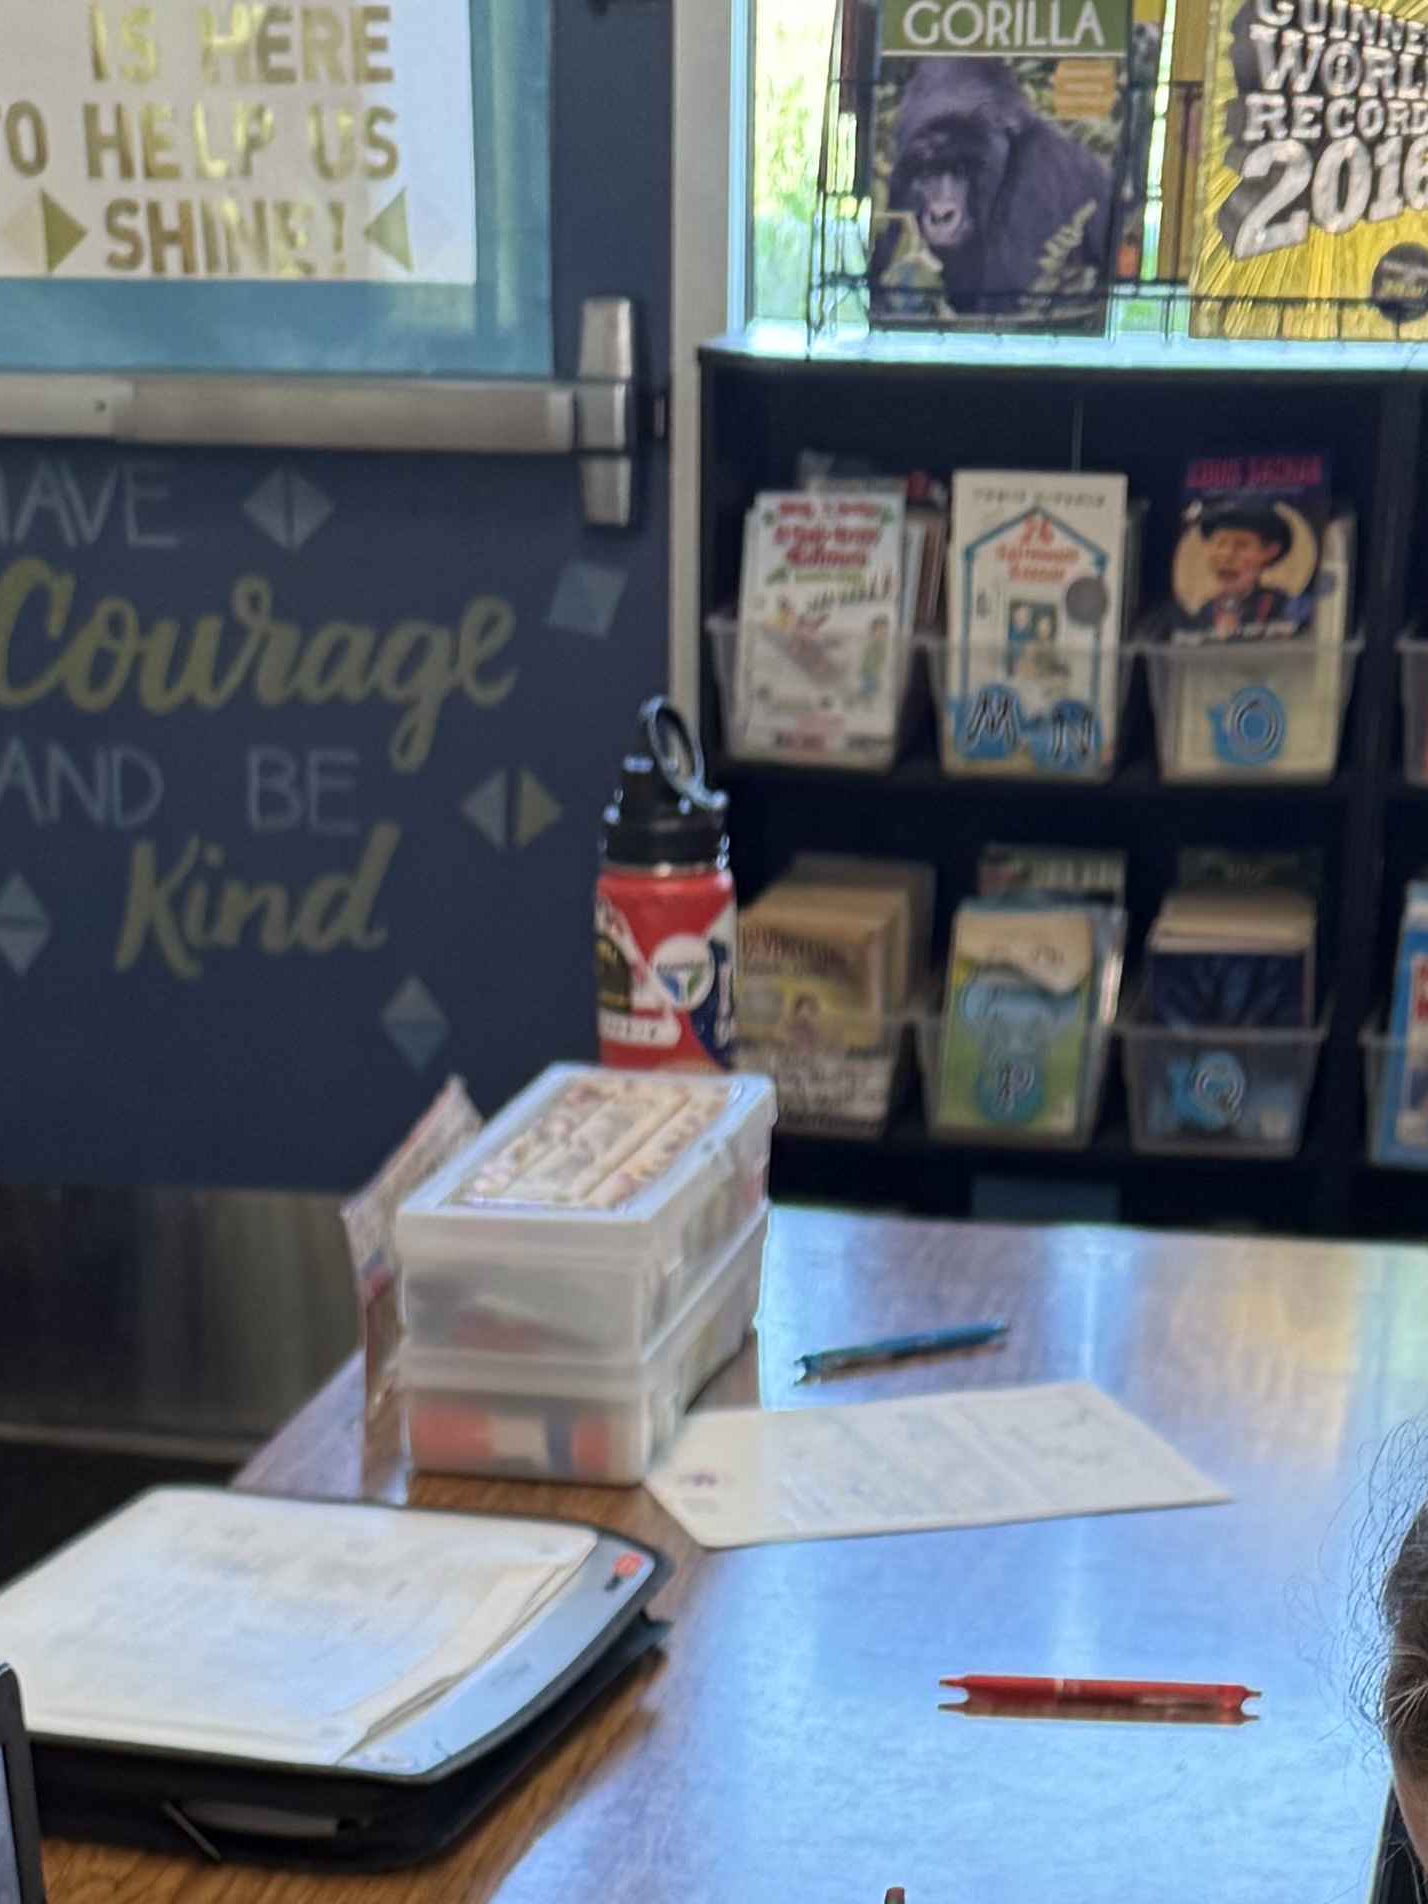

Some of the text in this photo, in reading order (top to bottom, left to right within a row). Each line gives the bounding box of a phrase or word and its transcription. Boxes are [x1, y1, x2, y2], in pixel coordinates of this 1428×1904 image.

[89, 2, 394, 84] IS HERE
[902, 0, 1105, 49] GORILLA
[84, 102, 274, 180] HELP
[310, 105, 400, 181] US
[106, 199, 347, 277] SHINE!
[247, 747, 360, 835] BE
[115, 822, 401, 980] Kind
